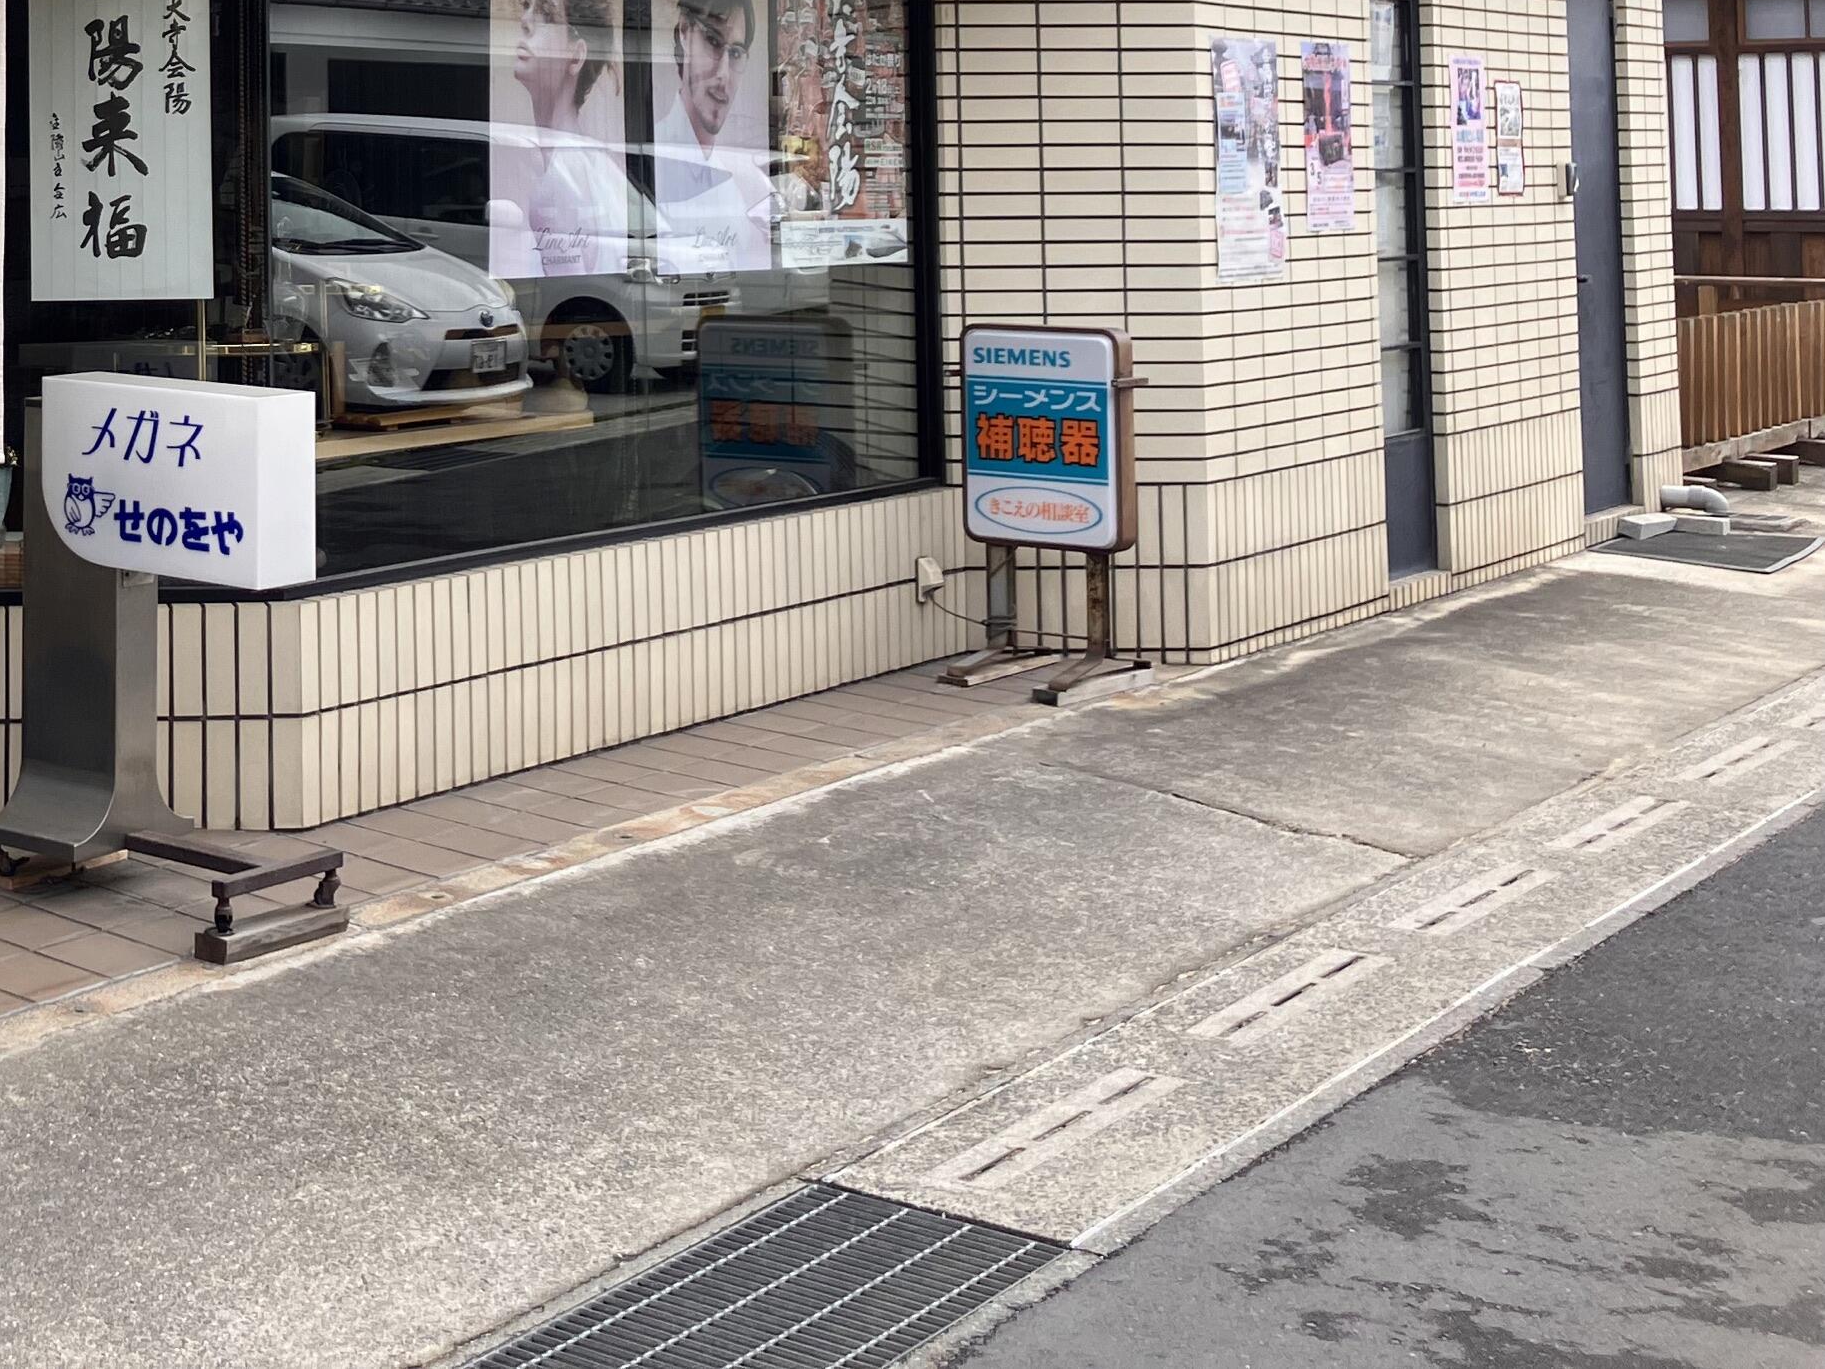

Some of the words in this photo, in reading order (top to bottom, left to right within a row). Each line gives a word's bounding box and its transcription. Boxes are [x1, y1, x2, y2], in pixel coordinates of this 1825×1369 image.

[973, 346, 1071, 369] SIEMENS
[973, 385, 1101, 412] シーメンス
[82, 408, 203, 467] メガネ
[976, 412, 1100, 467] 補聴器
[114, 499, 244, 556] せのをや
[989, 498, 1091, 524] きこえの相談室
